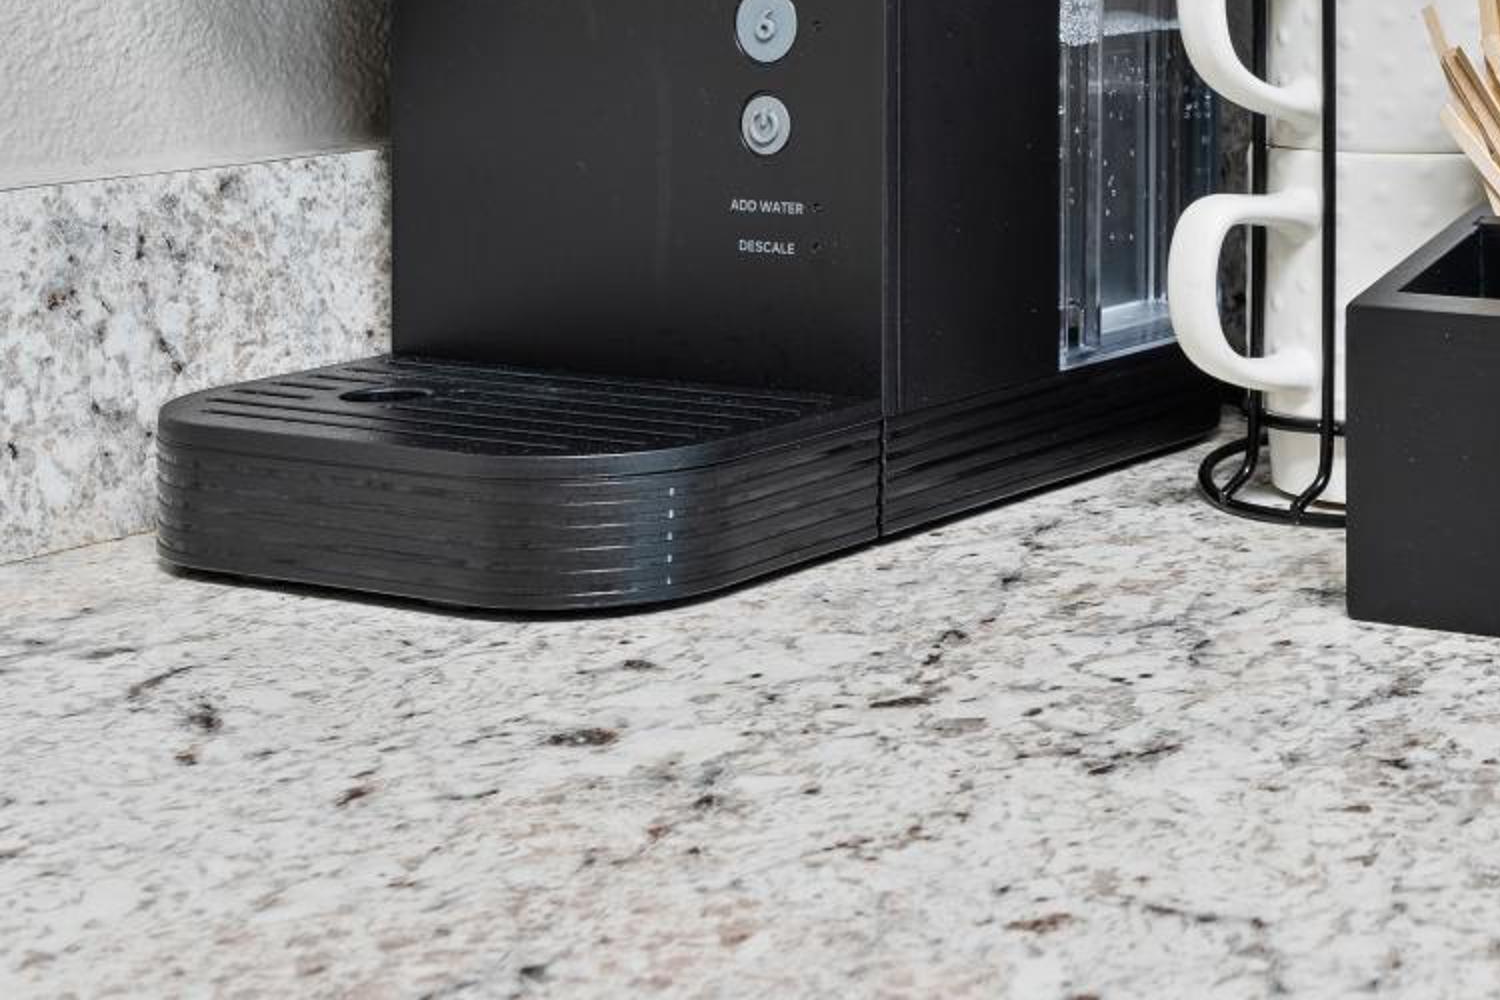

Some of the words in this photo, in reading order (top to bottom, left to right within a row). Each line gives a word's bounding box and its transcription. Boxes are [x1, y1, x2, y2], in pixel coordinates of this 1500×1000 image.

[754, 8, 776, 44] 6
[730, 199, 757, 212] ADD
[759, 200, 804, 215] WATER
[739, 239, 795, 255] DESCALE
